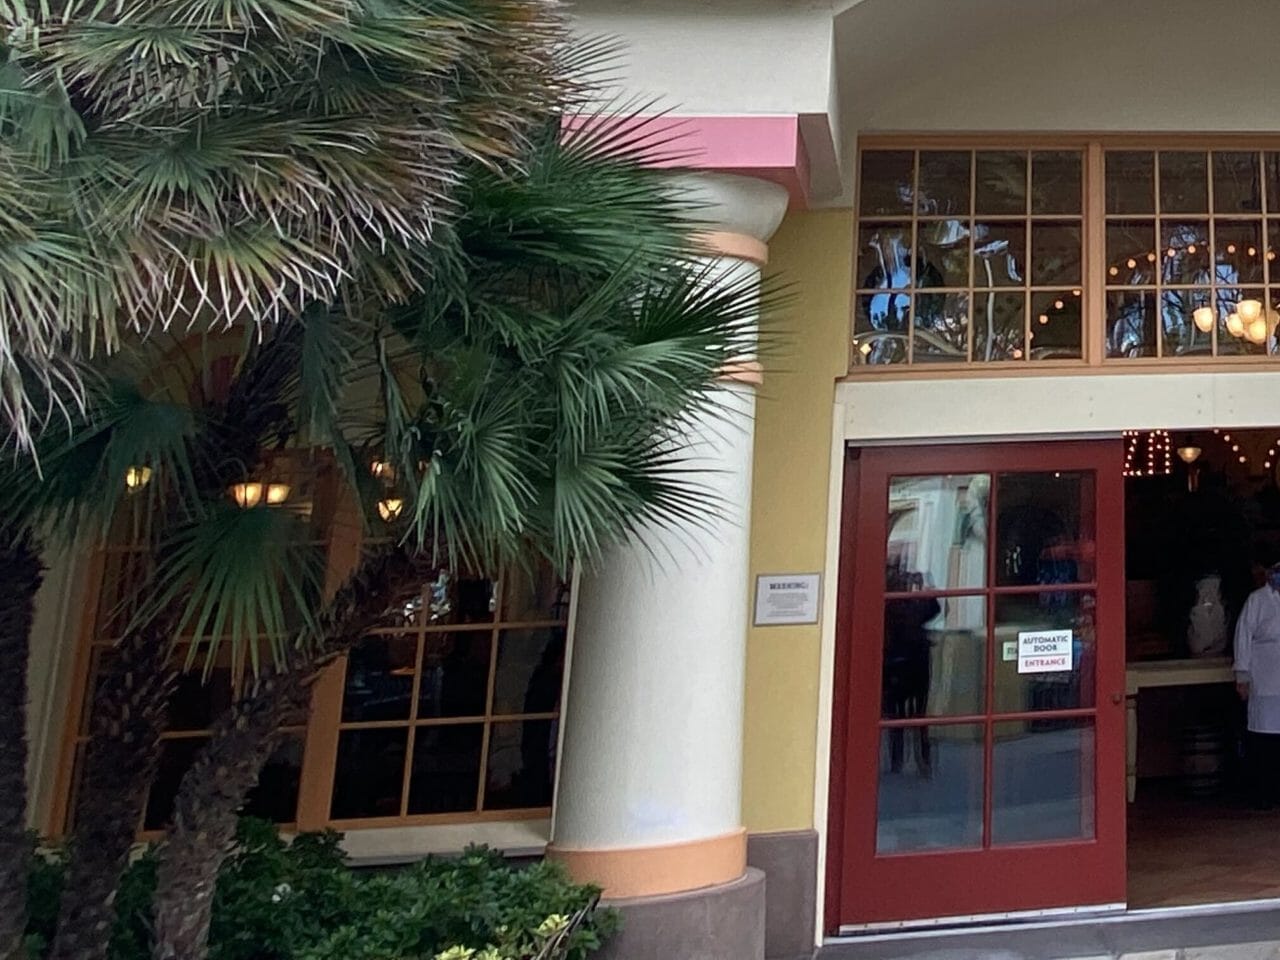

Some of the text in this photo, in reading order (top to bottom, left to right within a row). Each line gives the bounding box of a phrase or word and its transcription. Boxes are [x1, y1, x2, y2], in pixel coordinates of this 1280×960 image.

[1022, 635, 1069, 645] AUTOMATIC
[1033, 644, 1058, 653] DOOR
[1024, 657, 1066, 668] ENTRANCE
